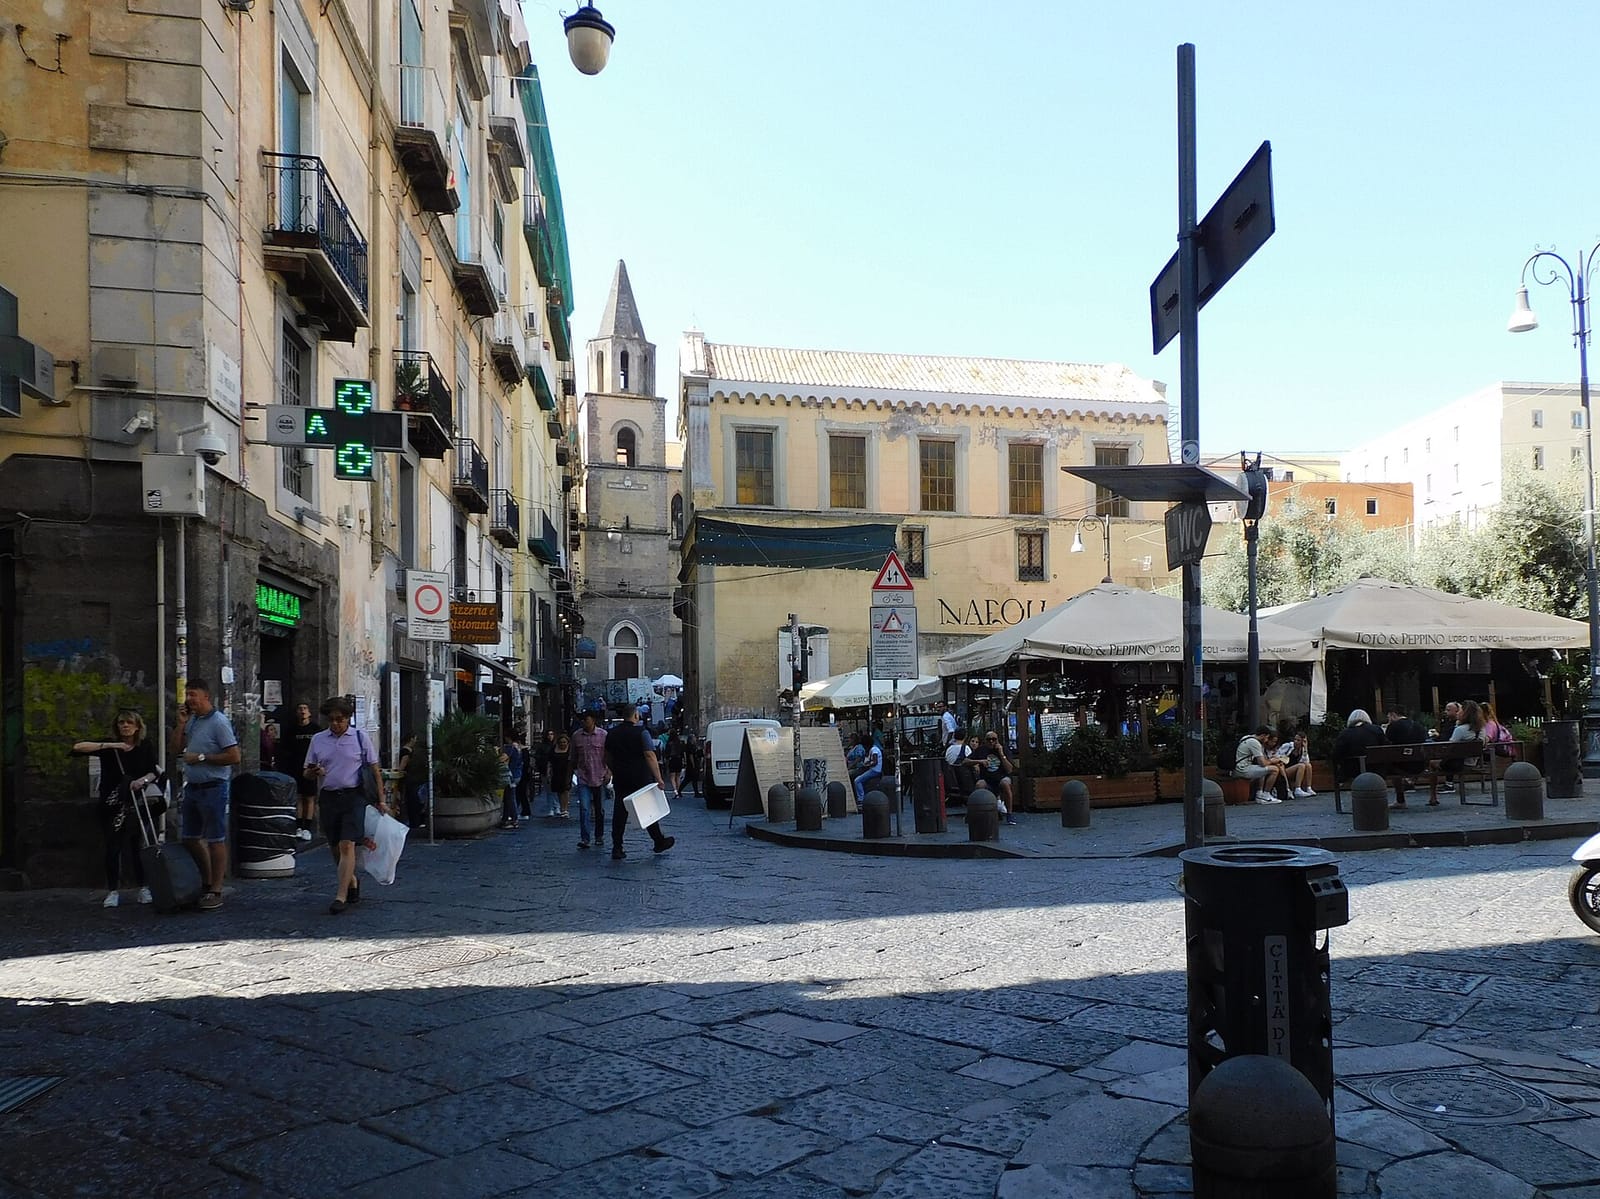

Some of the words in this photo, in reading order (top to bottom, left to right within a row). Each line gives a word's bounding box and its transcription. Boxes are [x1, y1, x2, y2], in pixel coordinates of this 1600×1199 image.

[1178, 505, 1204, 553] WC
[255, 582, 300, 619] ARMACIA
[449, 603, 487, 616] Pizzeria
[489, 607, 495, 616] e
[449, 618, 495, 631] Ristorante
[1389, 633, 1400, 645] &
[1401, 632, 1445, 645] PEPPINO
[1479, 635, 1504, 643] NAPOLI
[1096, 645, 1106, 656] &
[1109, 643, 1156, 656] PEPPINO
[1203, 646, 1219, 654] POLI
[853, 694, 883, 704] RISTOANTE
